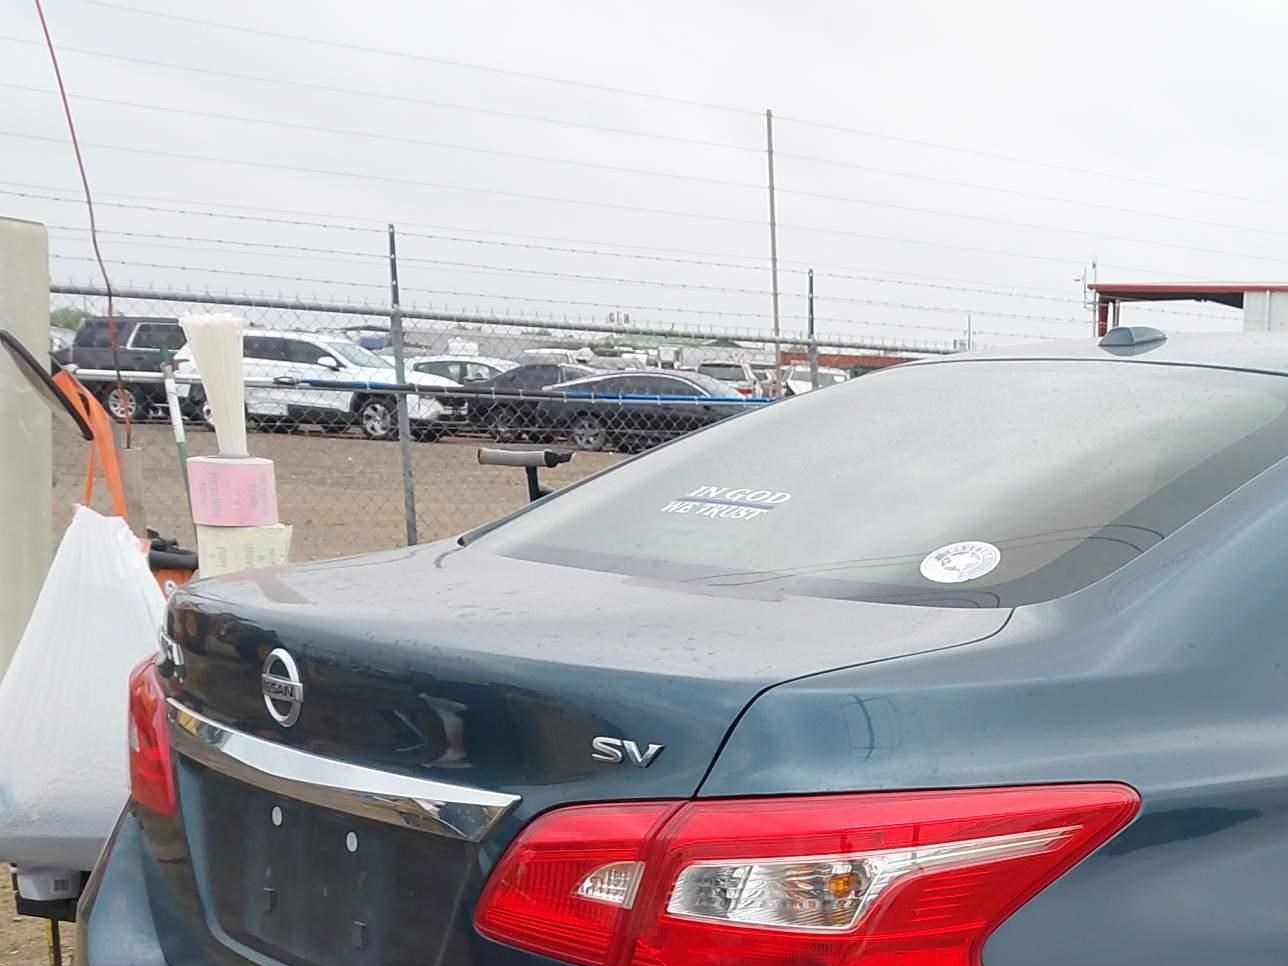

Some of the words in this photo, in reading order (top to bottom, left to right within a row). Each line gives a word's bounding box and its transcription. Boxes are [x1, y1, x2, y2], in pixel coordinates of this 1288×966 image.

[687, 486, 729, 498] IN
[724, 488, 792, 504] GOD
[661, 500, 700, 514] WE
[695, 502, 769, 520] TRUST
[591, 736, 665, 768] SV
